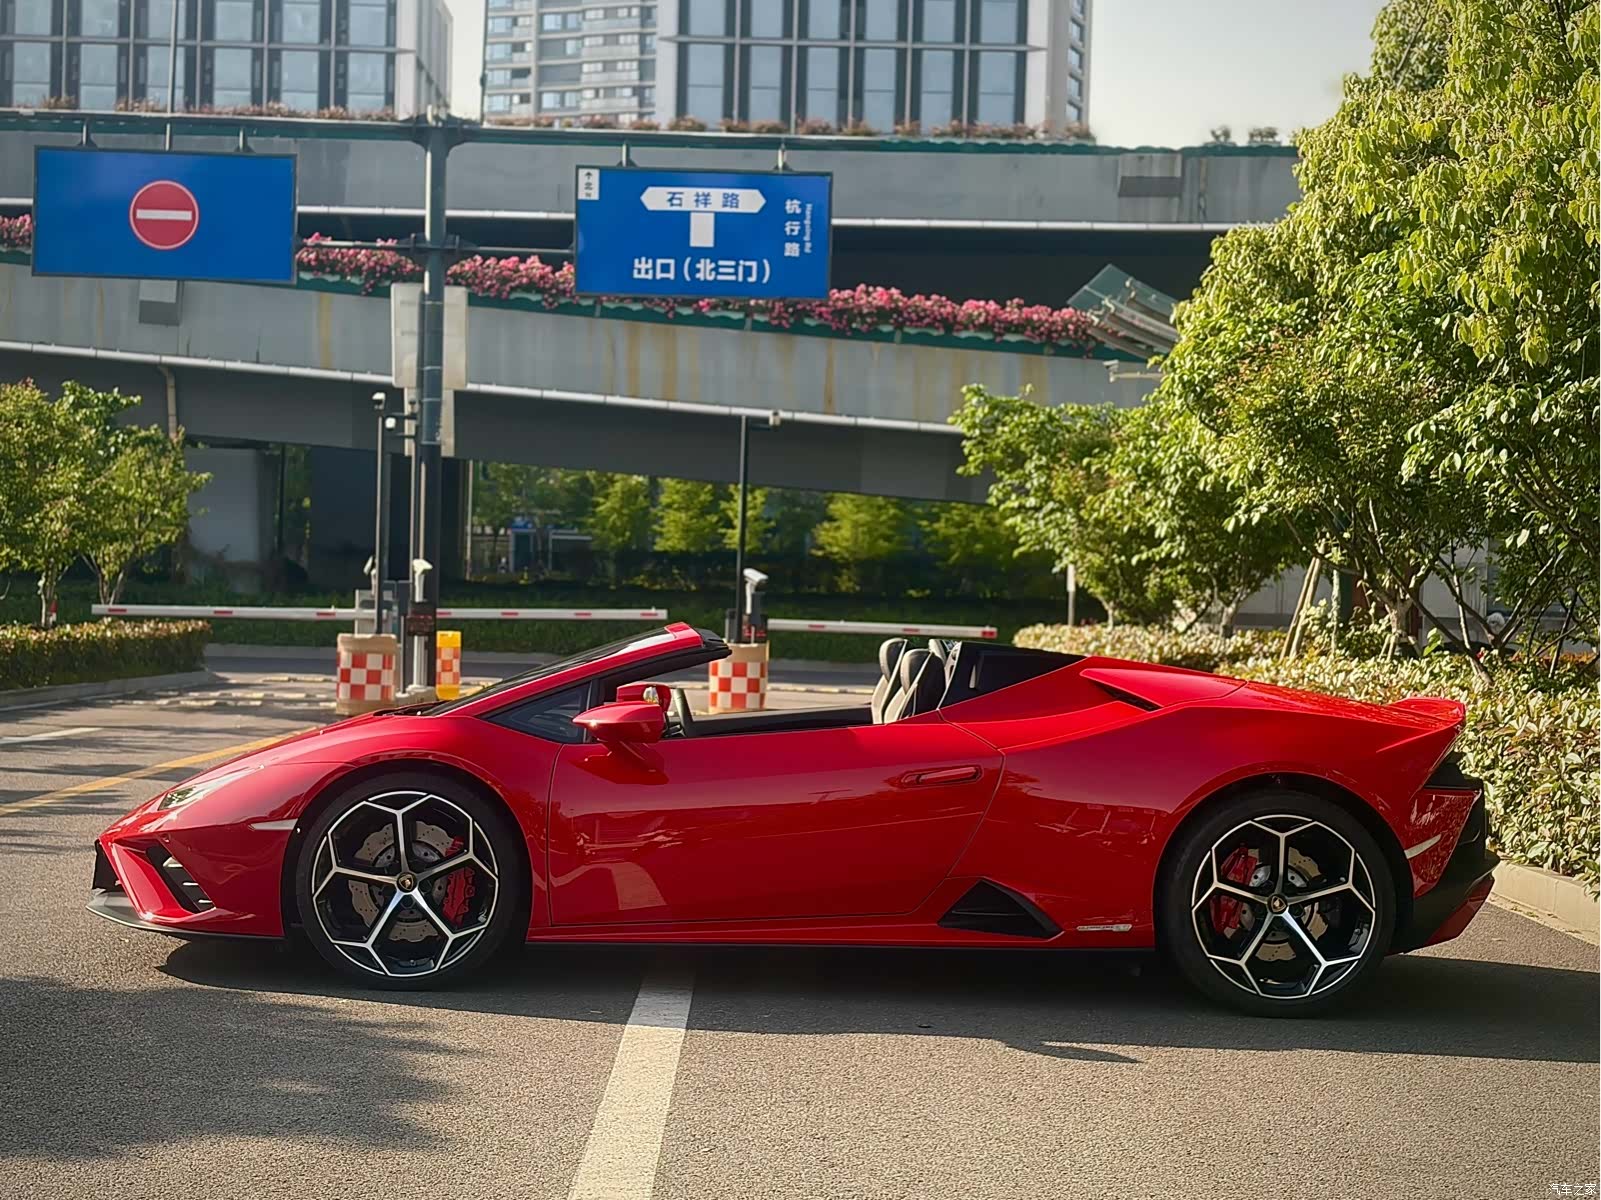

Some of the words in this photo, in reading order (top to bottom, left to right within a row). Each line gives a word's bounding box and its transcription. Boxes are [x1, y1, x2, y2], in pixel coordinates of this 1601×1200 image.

[667, 191, 740, 209] 石祥路
[784, 199, 801, 257] 杭行路
